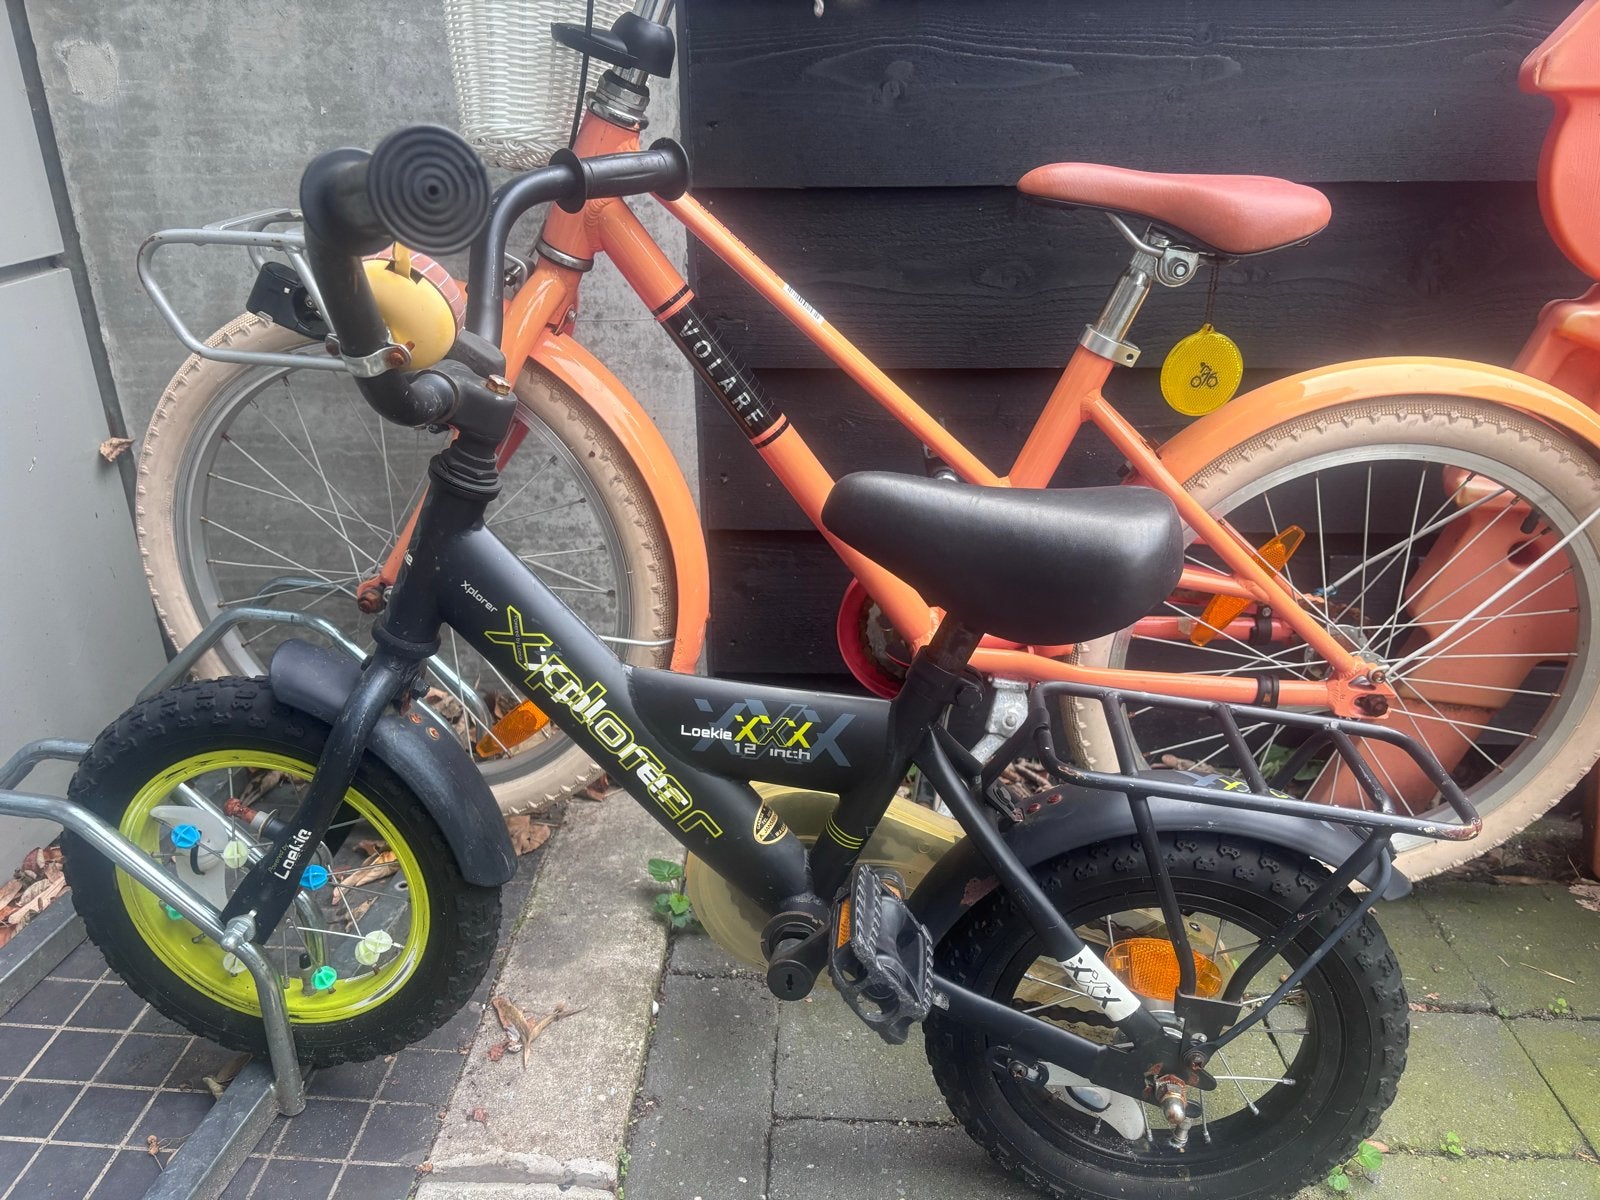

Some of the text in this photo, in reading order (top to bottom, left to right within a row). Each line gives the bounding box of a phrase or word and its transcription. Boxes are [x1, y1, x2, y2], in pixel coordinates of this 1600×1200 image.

[679, 318, 764, 427] VOLARE
[460, 580, 498, 613] Xplorer
[484, 605, 723, 838] Xplorer
[680, 724, 733, 741] Loekie
[734, 742, 811, 760] 12 inch
[274, 828, 312, 880] Loekie
